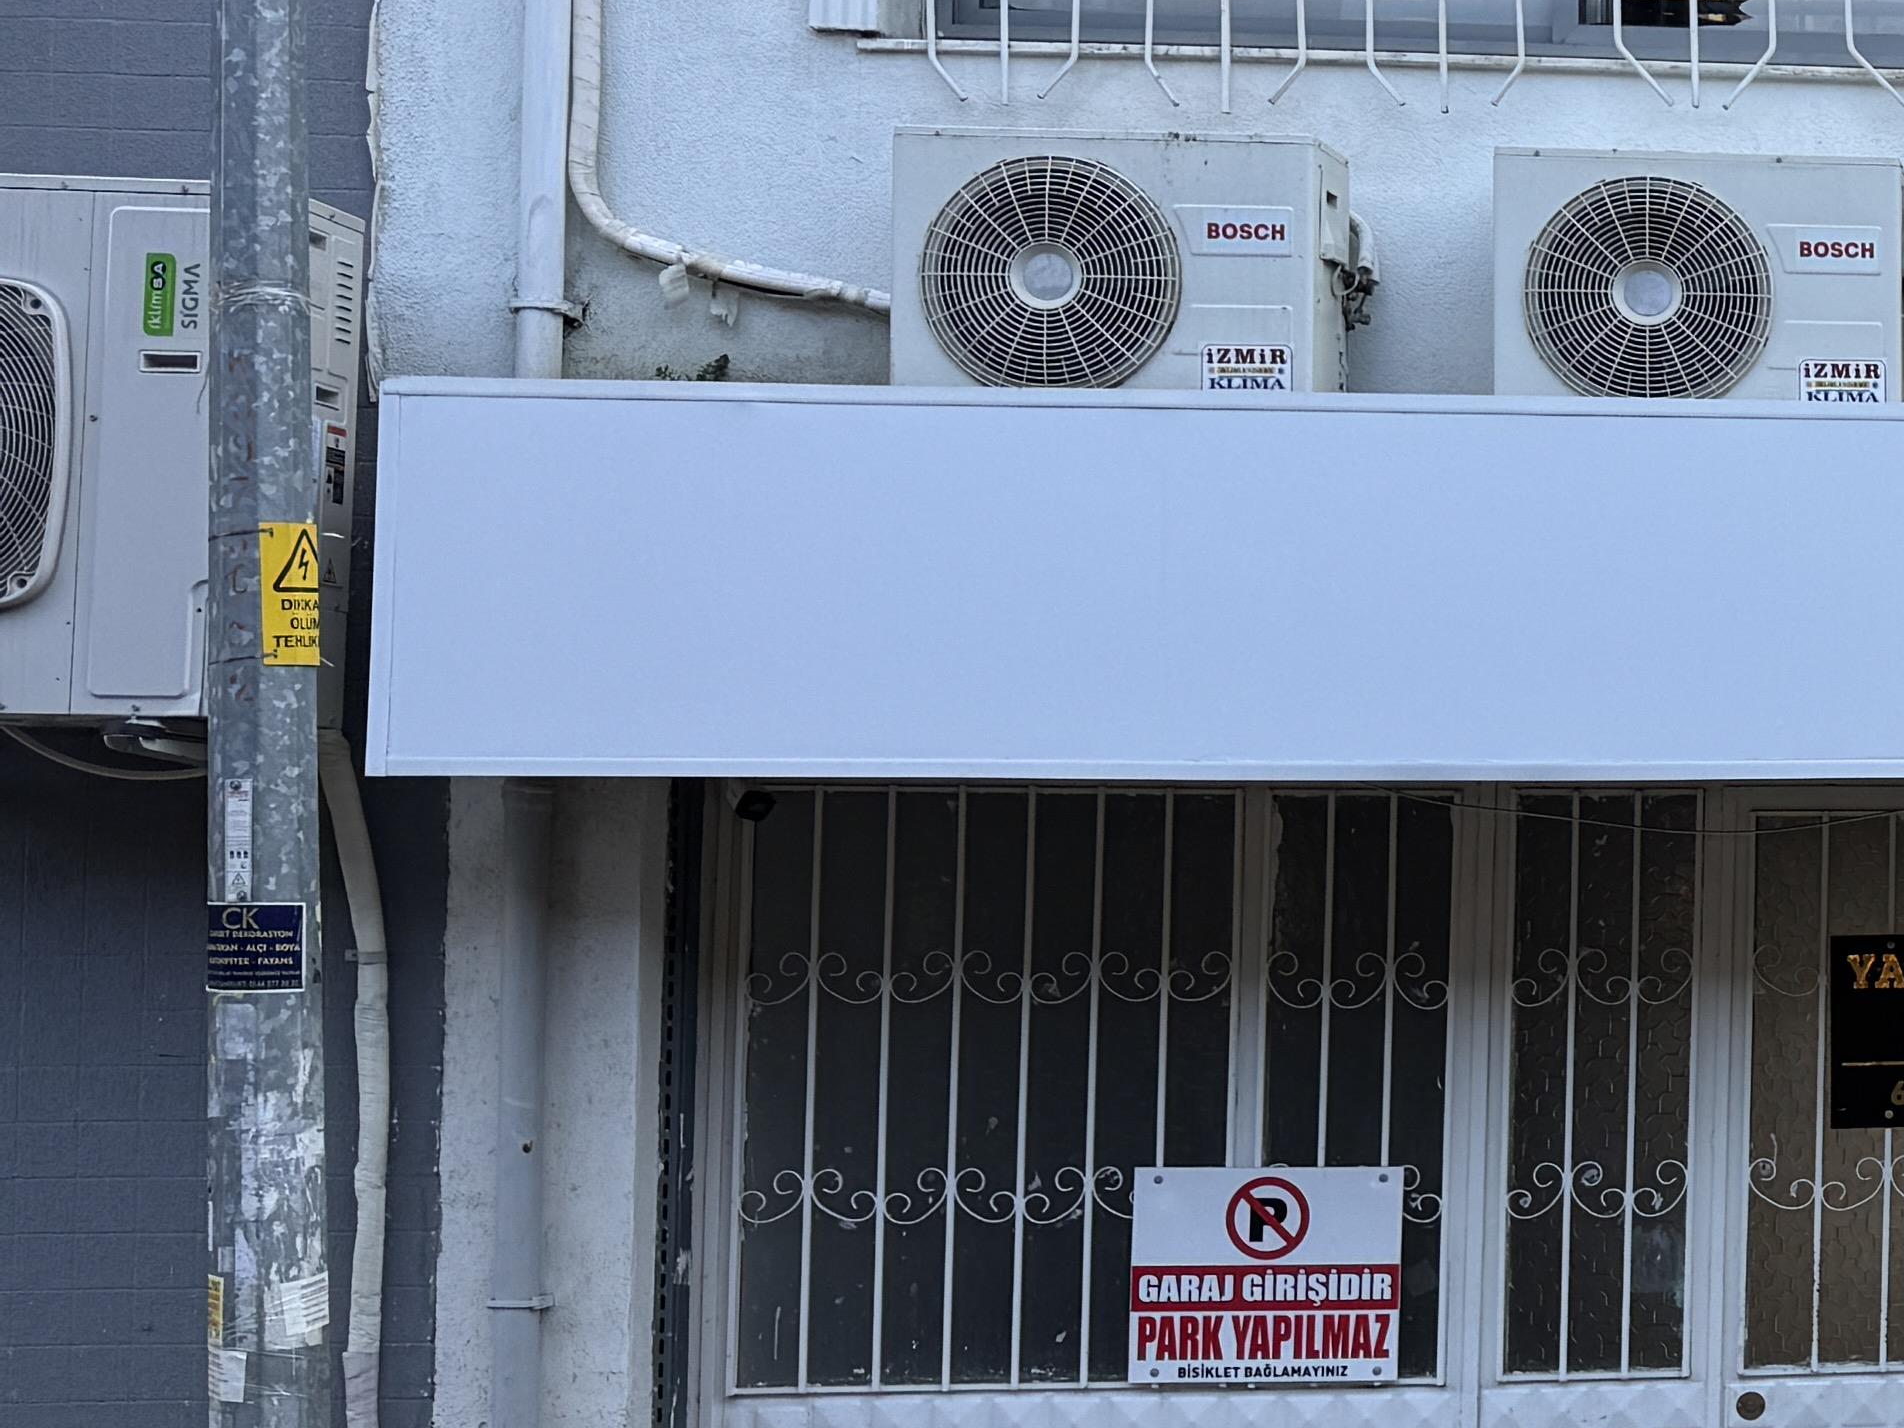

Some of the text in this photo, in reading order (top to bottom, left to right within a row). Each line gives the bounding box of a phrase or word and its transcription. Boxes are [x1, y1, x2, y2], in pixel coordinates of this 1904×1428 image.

[1206, 222, 1286, 242] BOSCH
[1800, 242, 1875, 259] BOSCH
[222, 907, 260, 929] CK
[1138, 1268, 1393, 1307] GARAJ GİRİŞİDİR
[1137, 1314, 1391, 1361] PARK YAPILMAZ
[1177, 1364, 1349, 1380] BİSİKLET BAĞLAMAYINIZ
